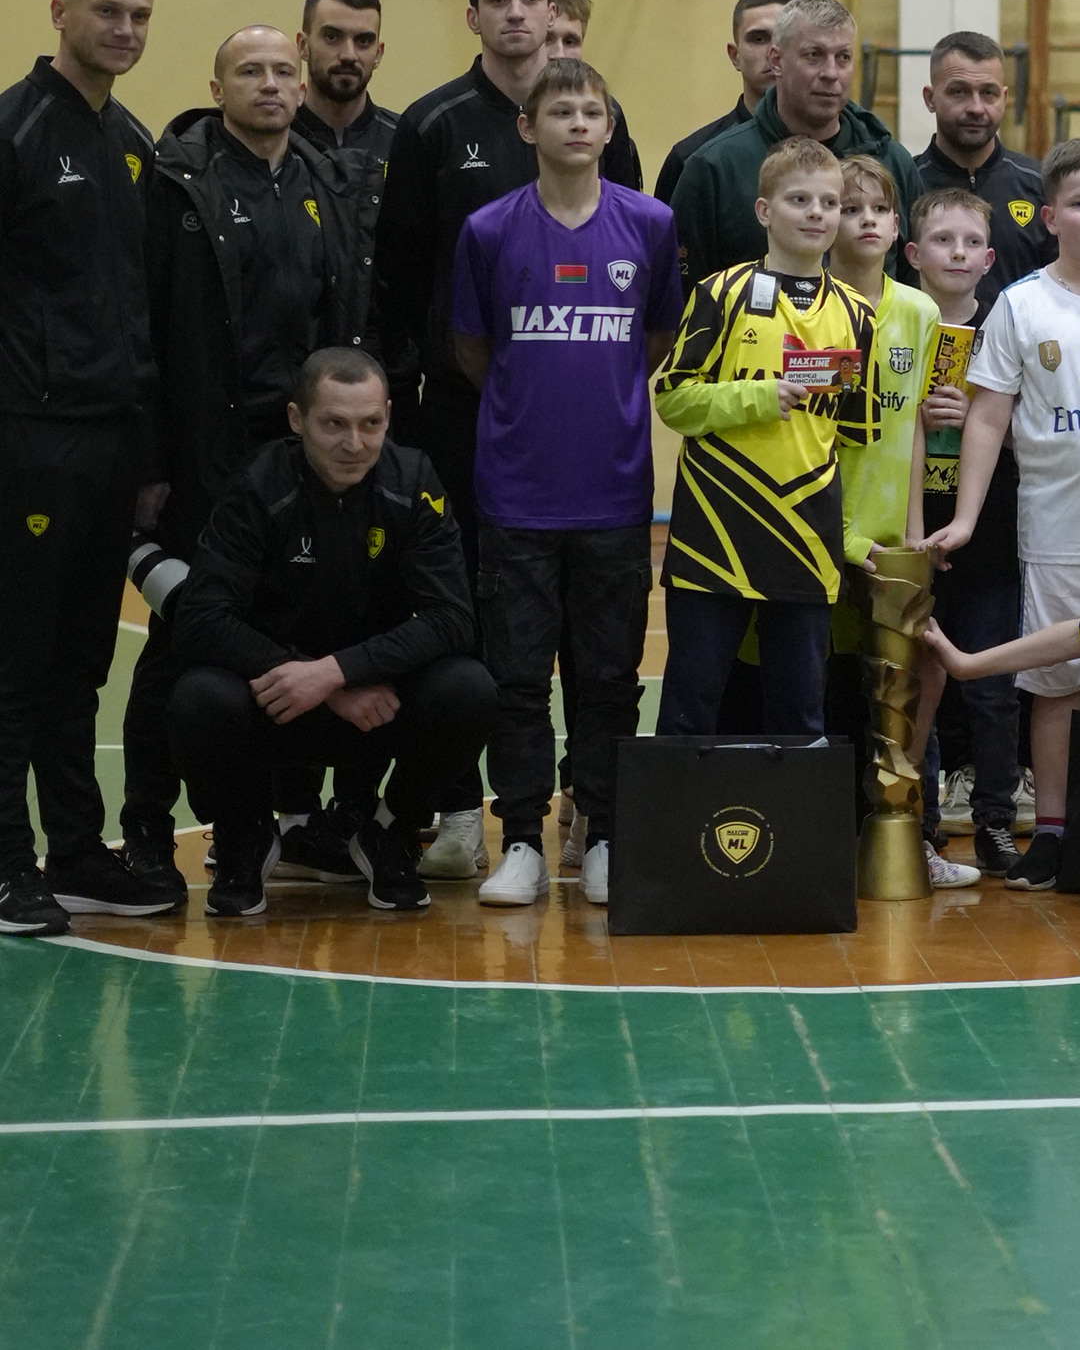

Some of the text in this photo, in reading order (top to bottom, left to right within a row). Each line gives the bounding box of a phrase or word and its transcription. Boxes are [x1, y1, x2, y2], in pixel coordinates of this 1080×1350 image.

[615, 270, 631, 280] ML
[788, 357, 831, 368] MAXLINE
[881, 391, 905, 412] tify
[727, 839, 747, 849] ML
